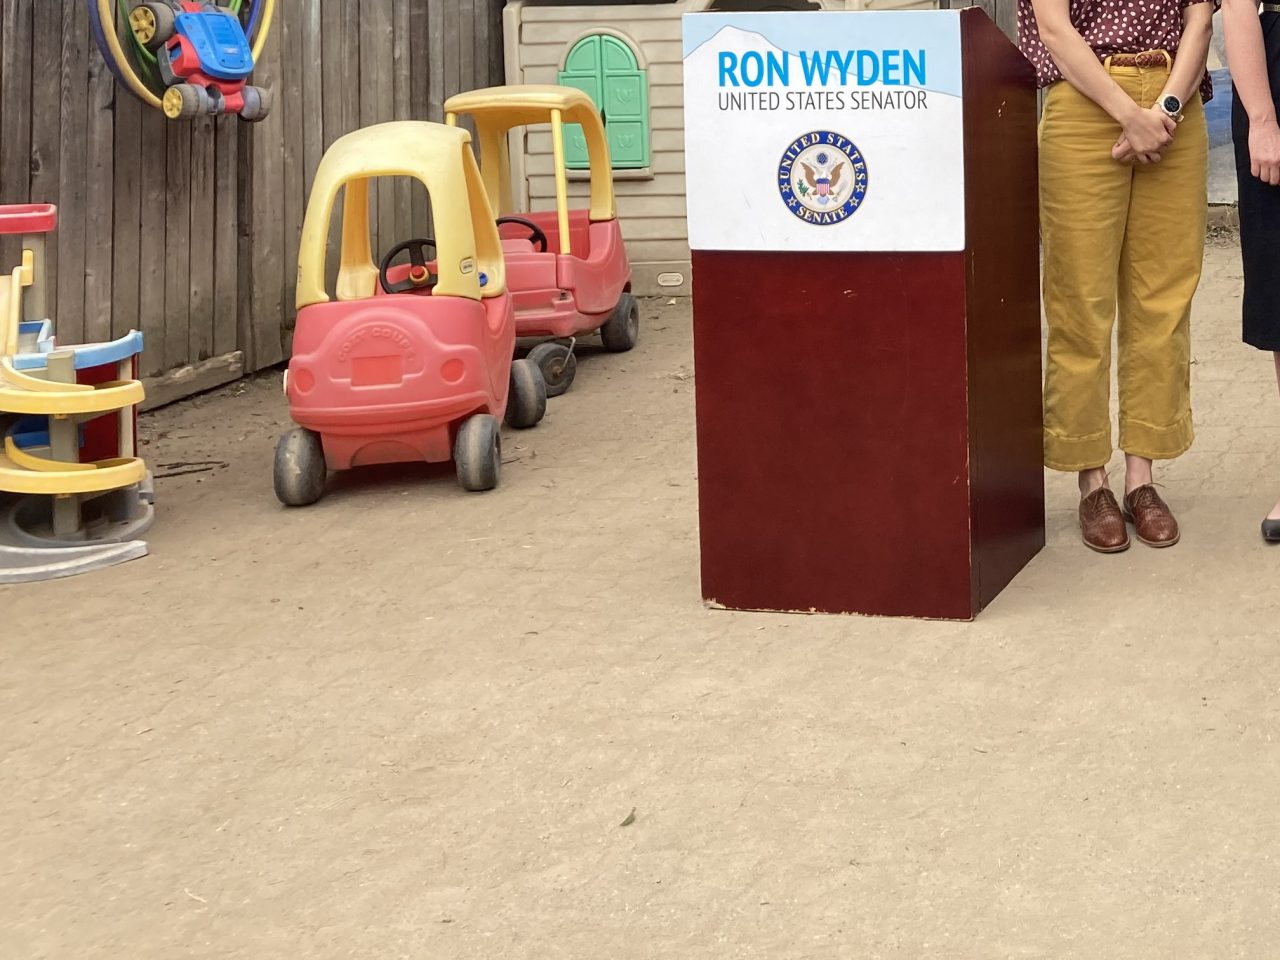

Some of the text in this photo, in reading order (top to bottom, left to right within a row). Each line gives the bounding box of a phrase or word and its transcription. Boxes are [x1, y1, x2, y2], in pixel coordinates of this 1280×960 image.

[718, 49, 926, 87] RON WYDEN
[718, 90, 928, 111] UNITED STATES SENATOR
[780, 133, 866, 180] UNITED STATES
[796, 206, 848, 223] SENATE
